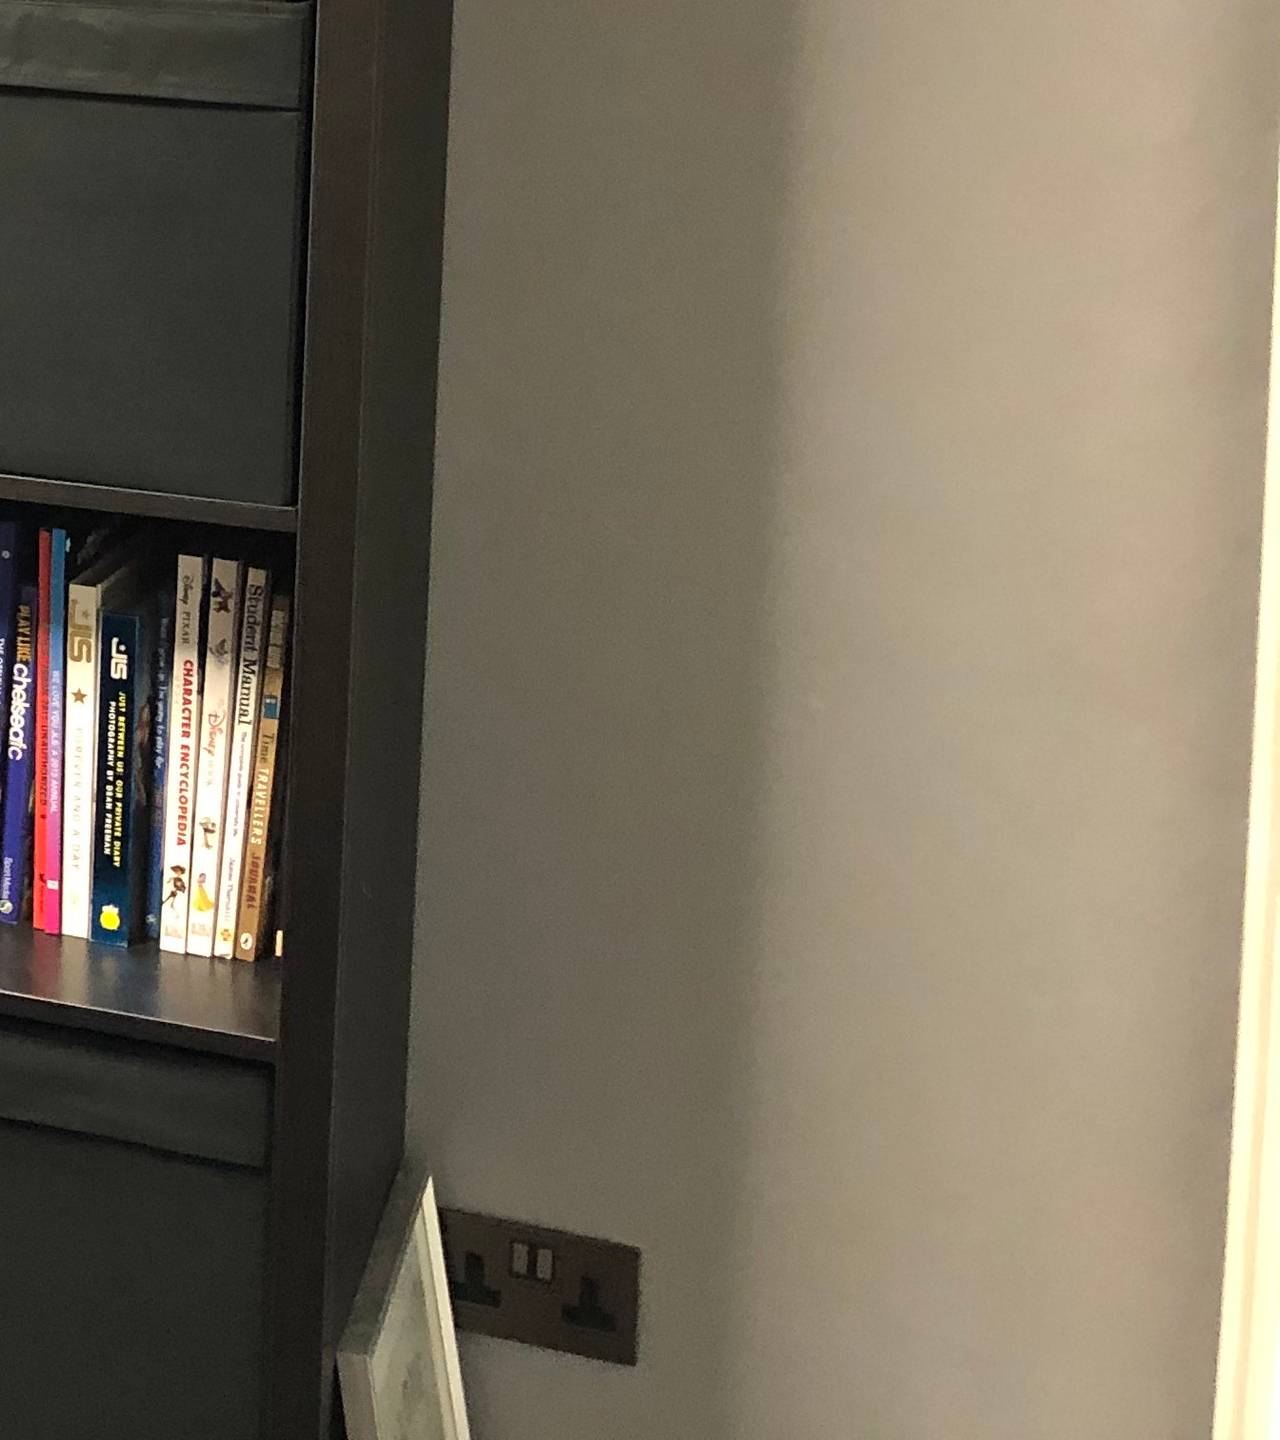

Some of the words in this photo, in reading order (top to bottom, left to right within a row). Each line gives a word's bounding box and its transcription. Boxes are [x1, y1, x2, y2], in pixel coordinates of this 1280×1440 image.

[18, 605, 33, 636] PLAY
[70, 598, 93, 663] JLS
[182, 611, 191, 644] PIXAR
[243, 584, 264, 653] Student
[16, 637, 32, 661] LIKE
[110, 637, 128, 679] JLS
[117, 691, 127, 713] JUST
[181, 659, 196, 739] CHARACTER
[238, 658, 257, 726] Manual
[106, 701, 117, 766] PHOTOGRAPHY
[116, 716, 126, 758] BETWEEN
[260, 732, 275, 764] Time
[106, 770, 115, 781] BY
[114, 780, 125, 798] OUR
[104, 785, 115, 810] DEAN
[176, 744, 191, 847] ENCYCLOPEDIA
[251, 768, 270, 845] TRAVELLERS
[103, 813, 114, 856] FREEMAN
[113, 802, 124, 836] PRIVATE
[112, 841, 122, 868] DIARY
